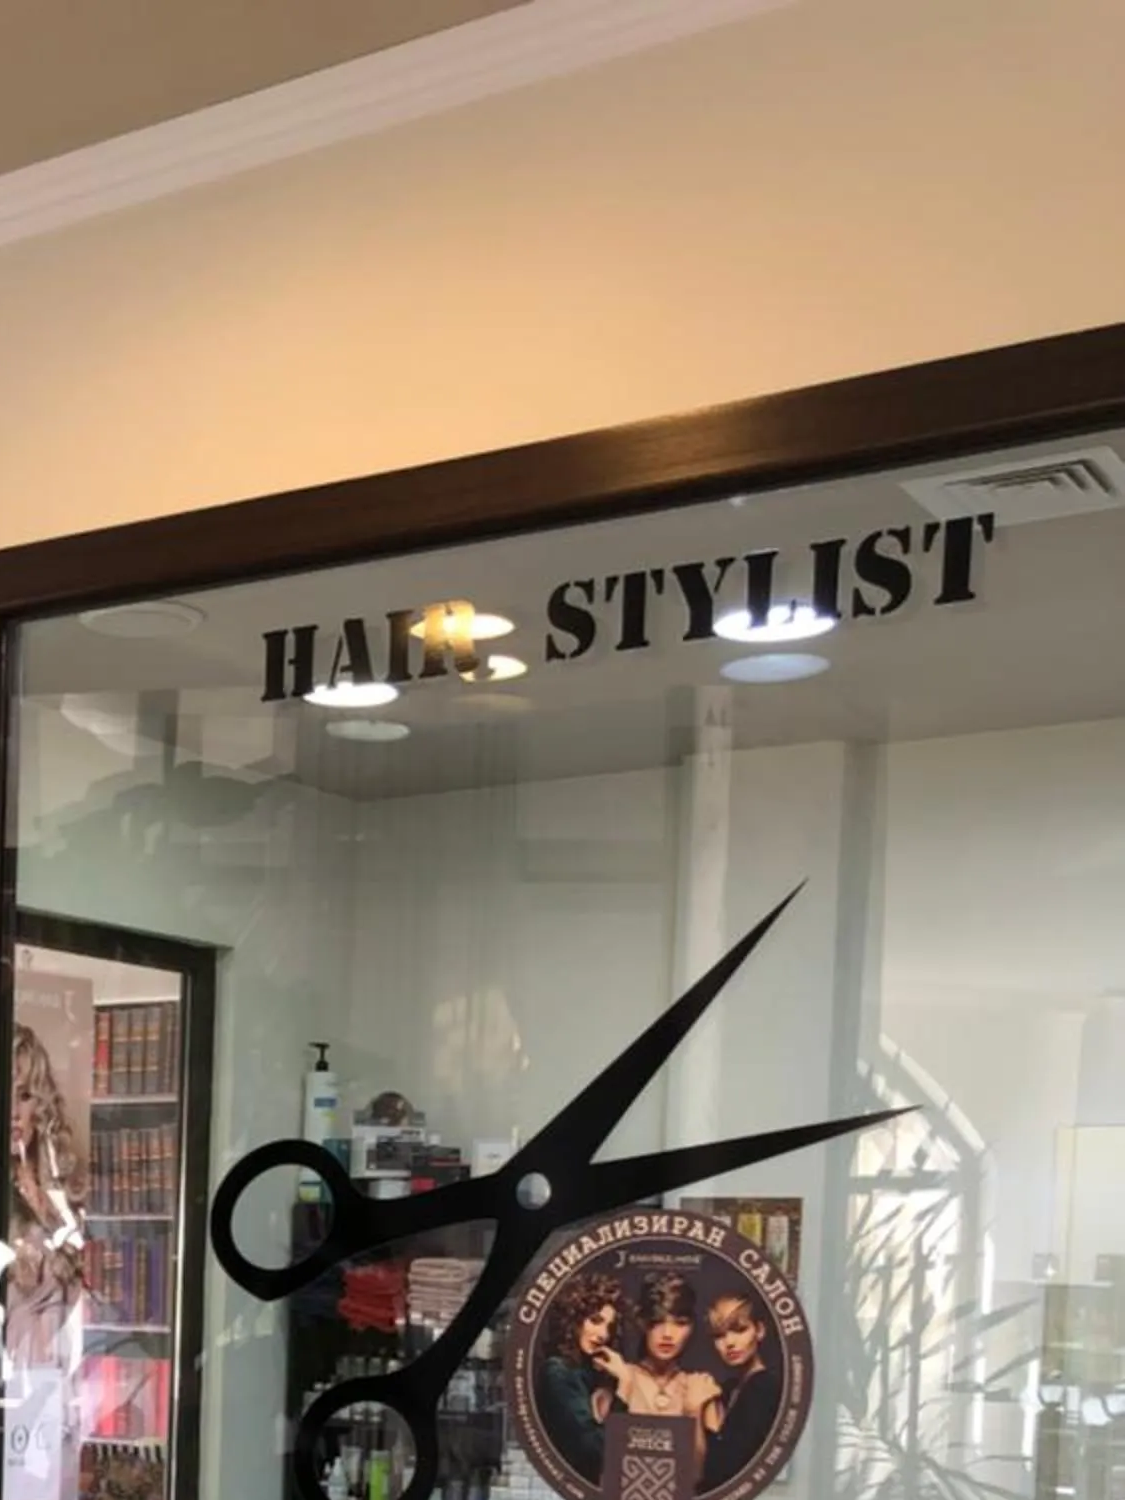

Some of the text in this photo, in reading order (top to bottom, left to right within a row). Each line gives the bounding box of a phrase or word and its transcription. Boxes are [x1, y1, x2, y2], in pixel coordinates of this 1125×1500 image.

[261, 512, 994, 702] HAIR STYLIST
[520, 1215, 803, 1335] СПЕЦИАЛИЗИРАН САЛОН
